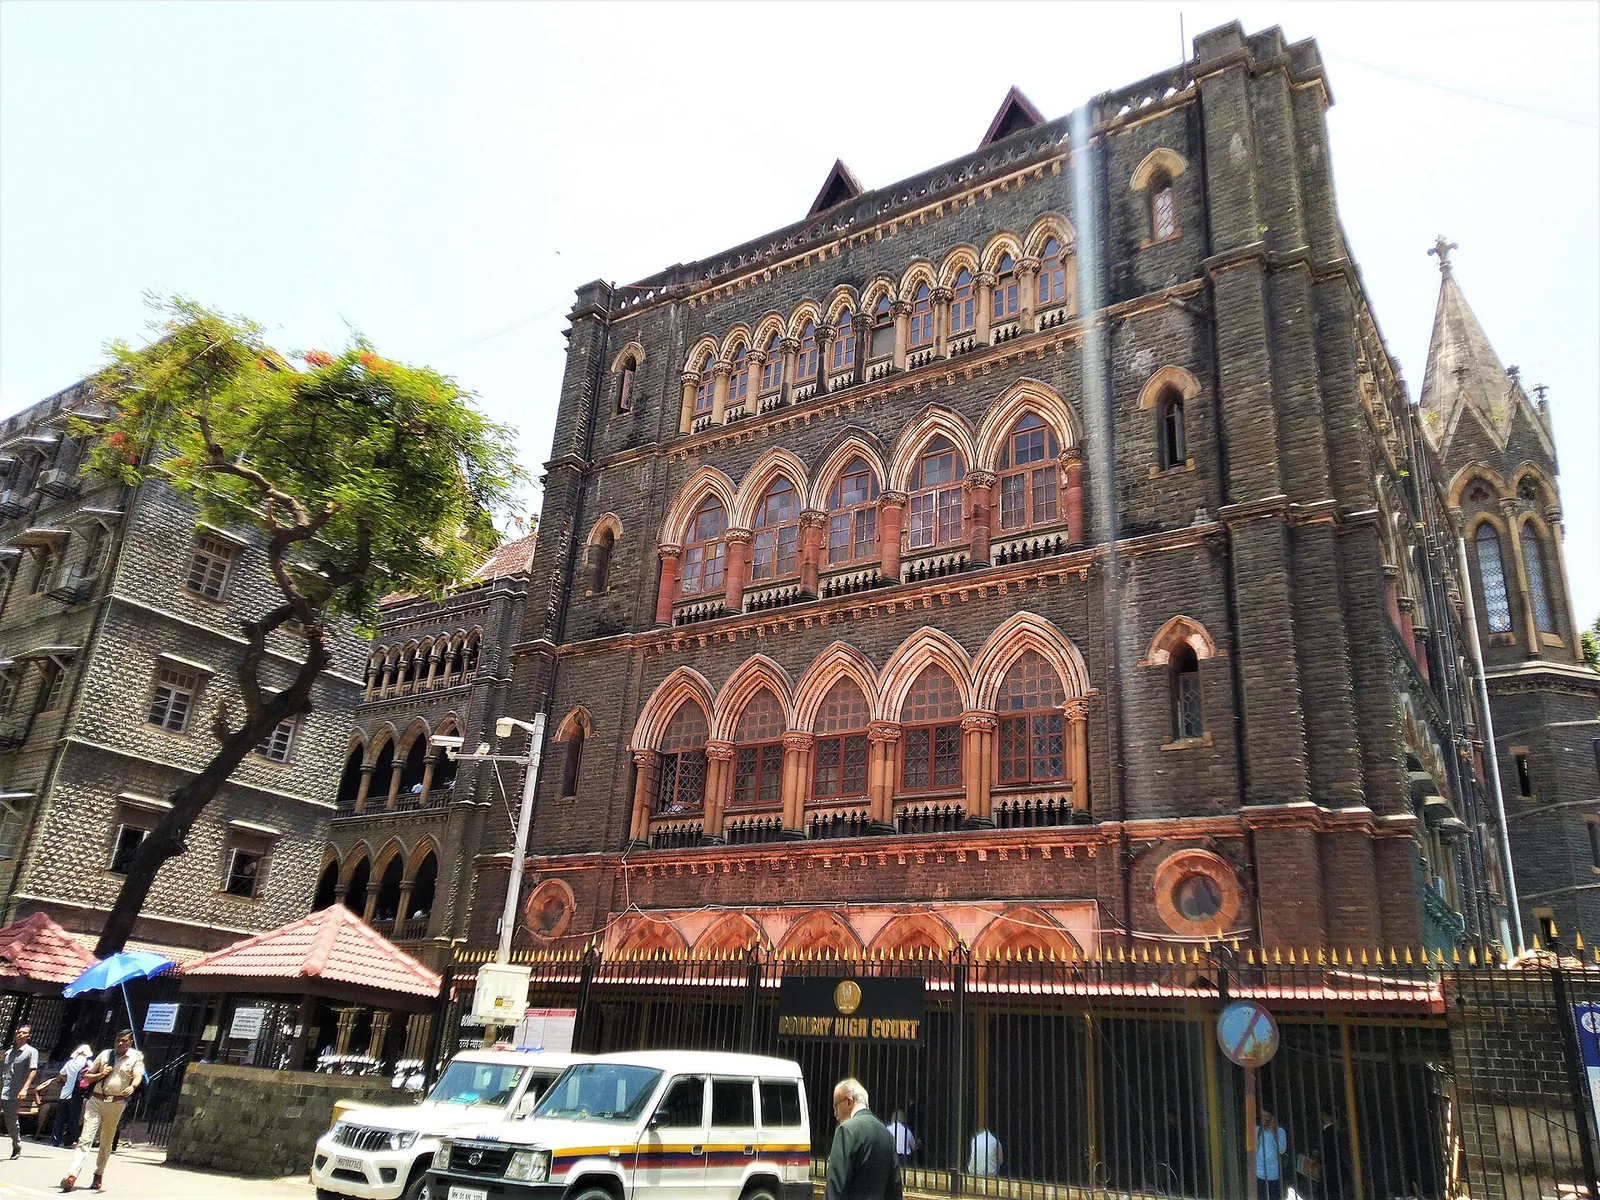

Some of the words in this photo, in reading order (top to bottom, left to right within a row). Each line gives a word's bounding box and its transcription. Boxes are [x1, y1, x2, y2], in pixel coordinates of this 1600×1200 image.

[778, 1016, 833, 1036] BOMBAY
[834, 1017, 869, 1038] HIGH
[871, 1018, 920, 1040] COURT
